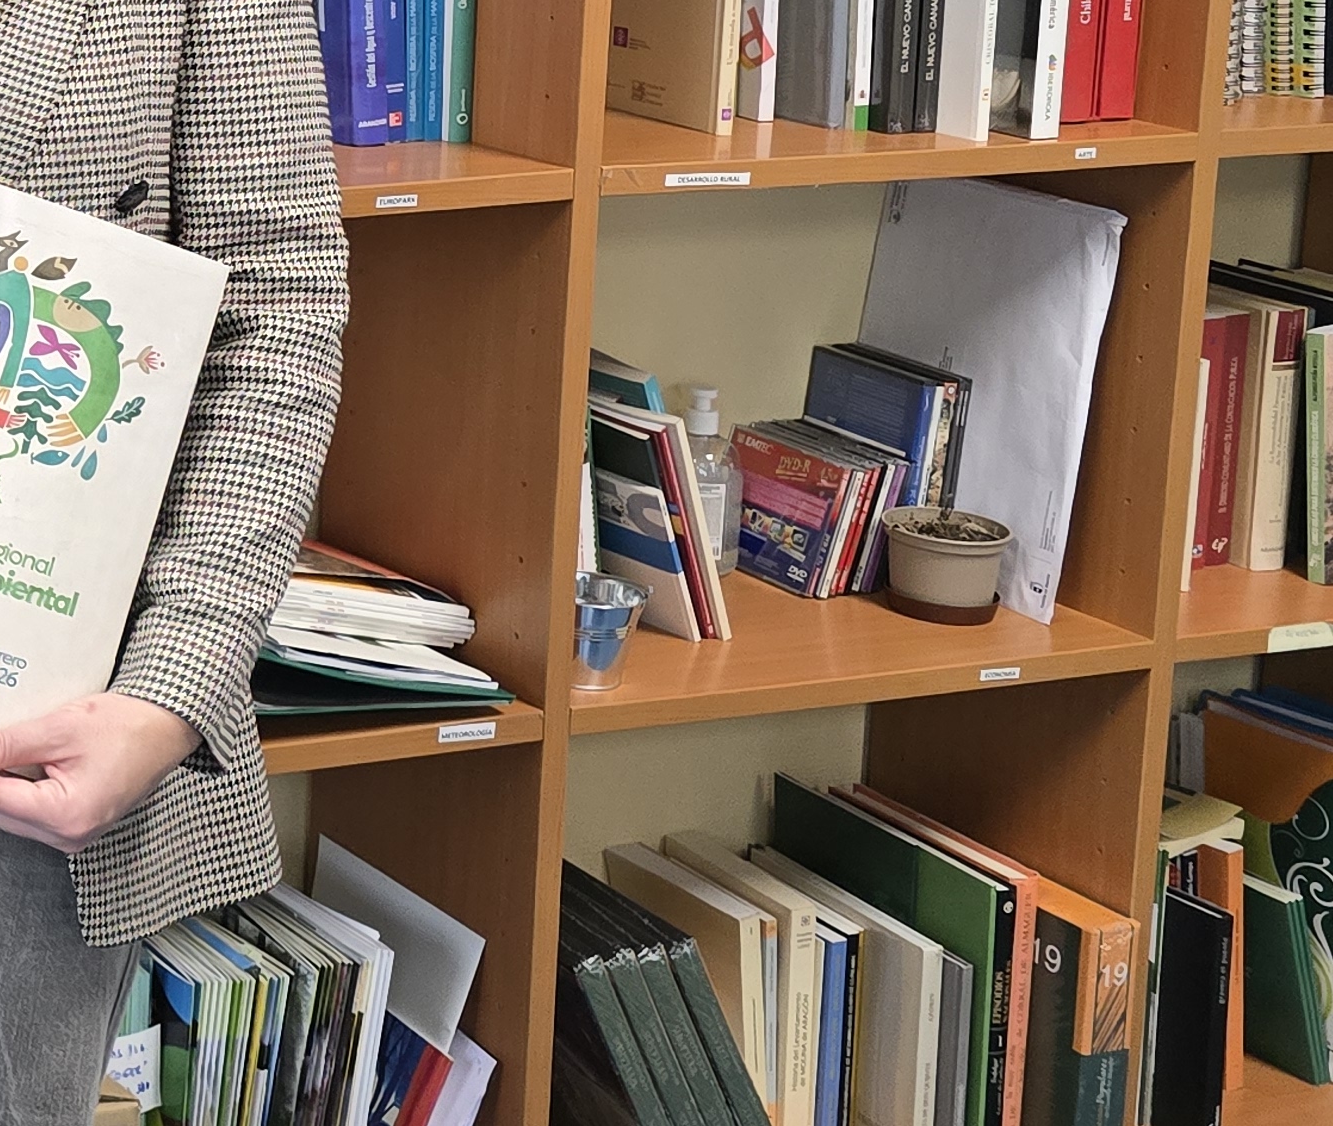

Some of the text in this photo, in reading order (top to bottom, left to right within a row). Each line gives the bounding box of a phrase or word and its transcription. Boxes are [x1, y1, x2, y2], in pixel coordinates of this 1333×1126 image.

[901, 23, 911, 60] NUEVO
[900, 61, 910, 74] EL
[677, 175, 741, 184] DESARROLLO RURAL
[441, 727, 493, 740] METEOROLOGÍA
[1099, 962, 1129, 988] 19
[991, 970, 1004, 1025] EPISODIOS
